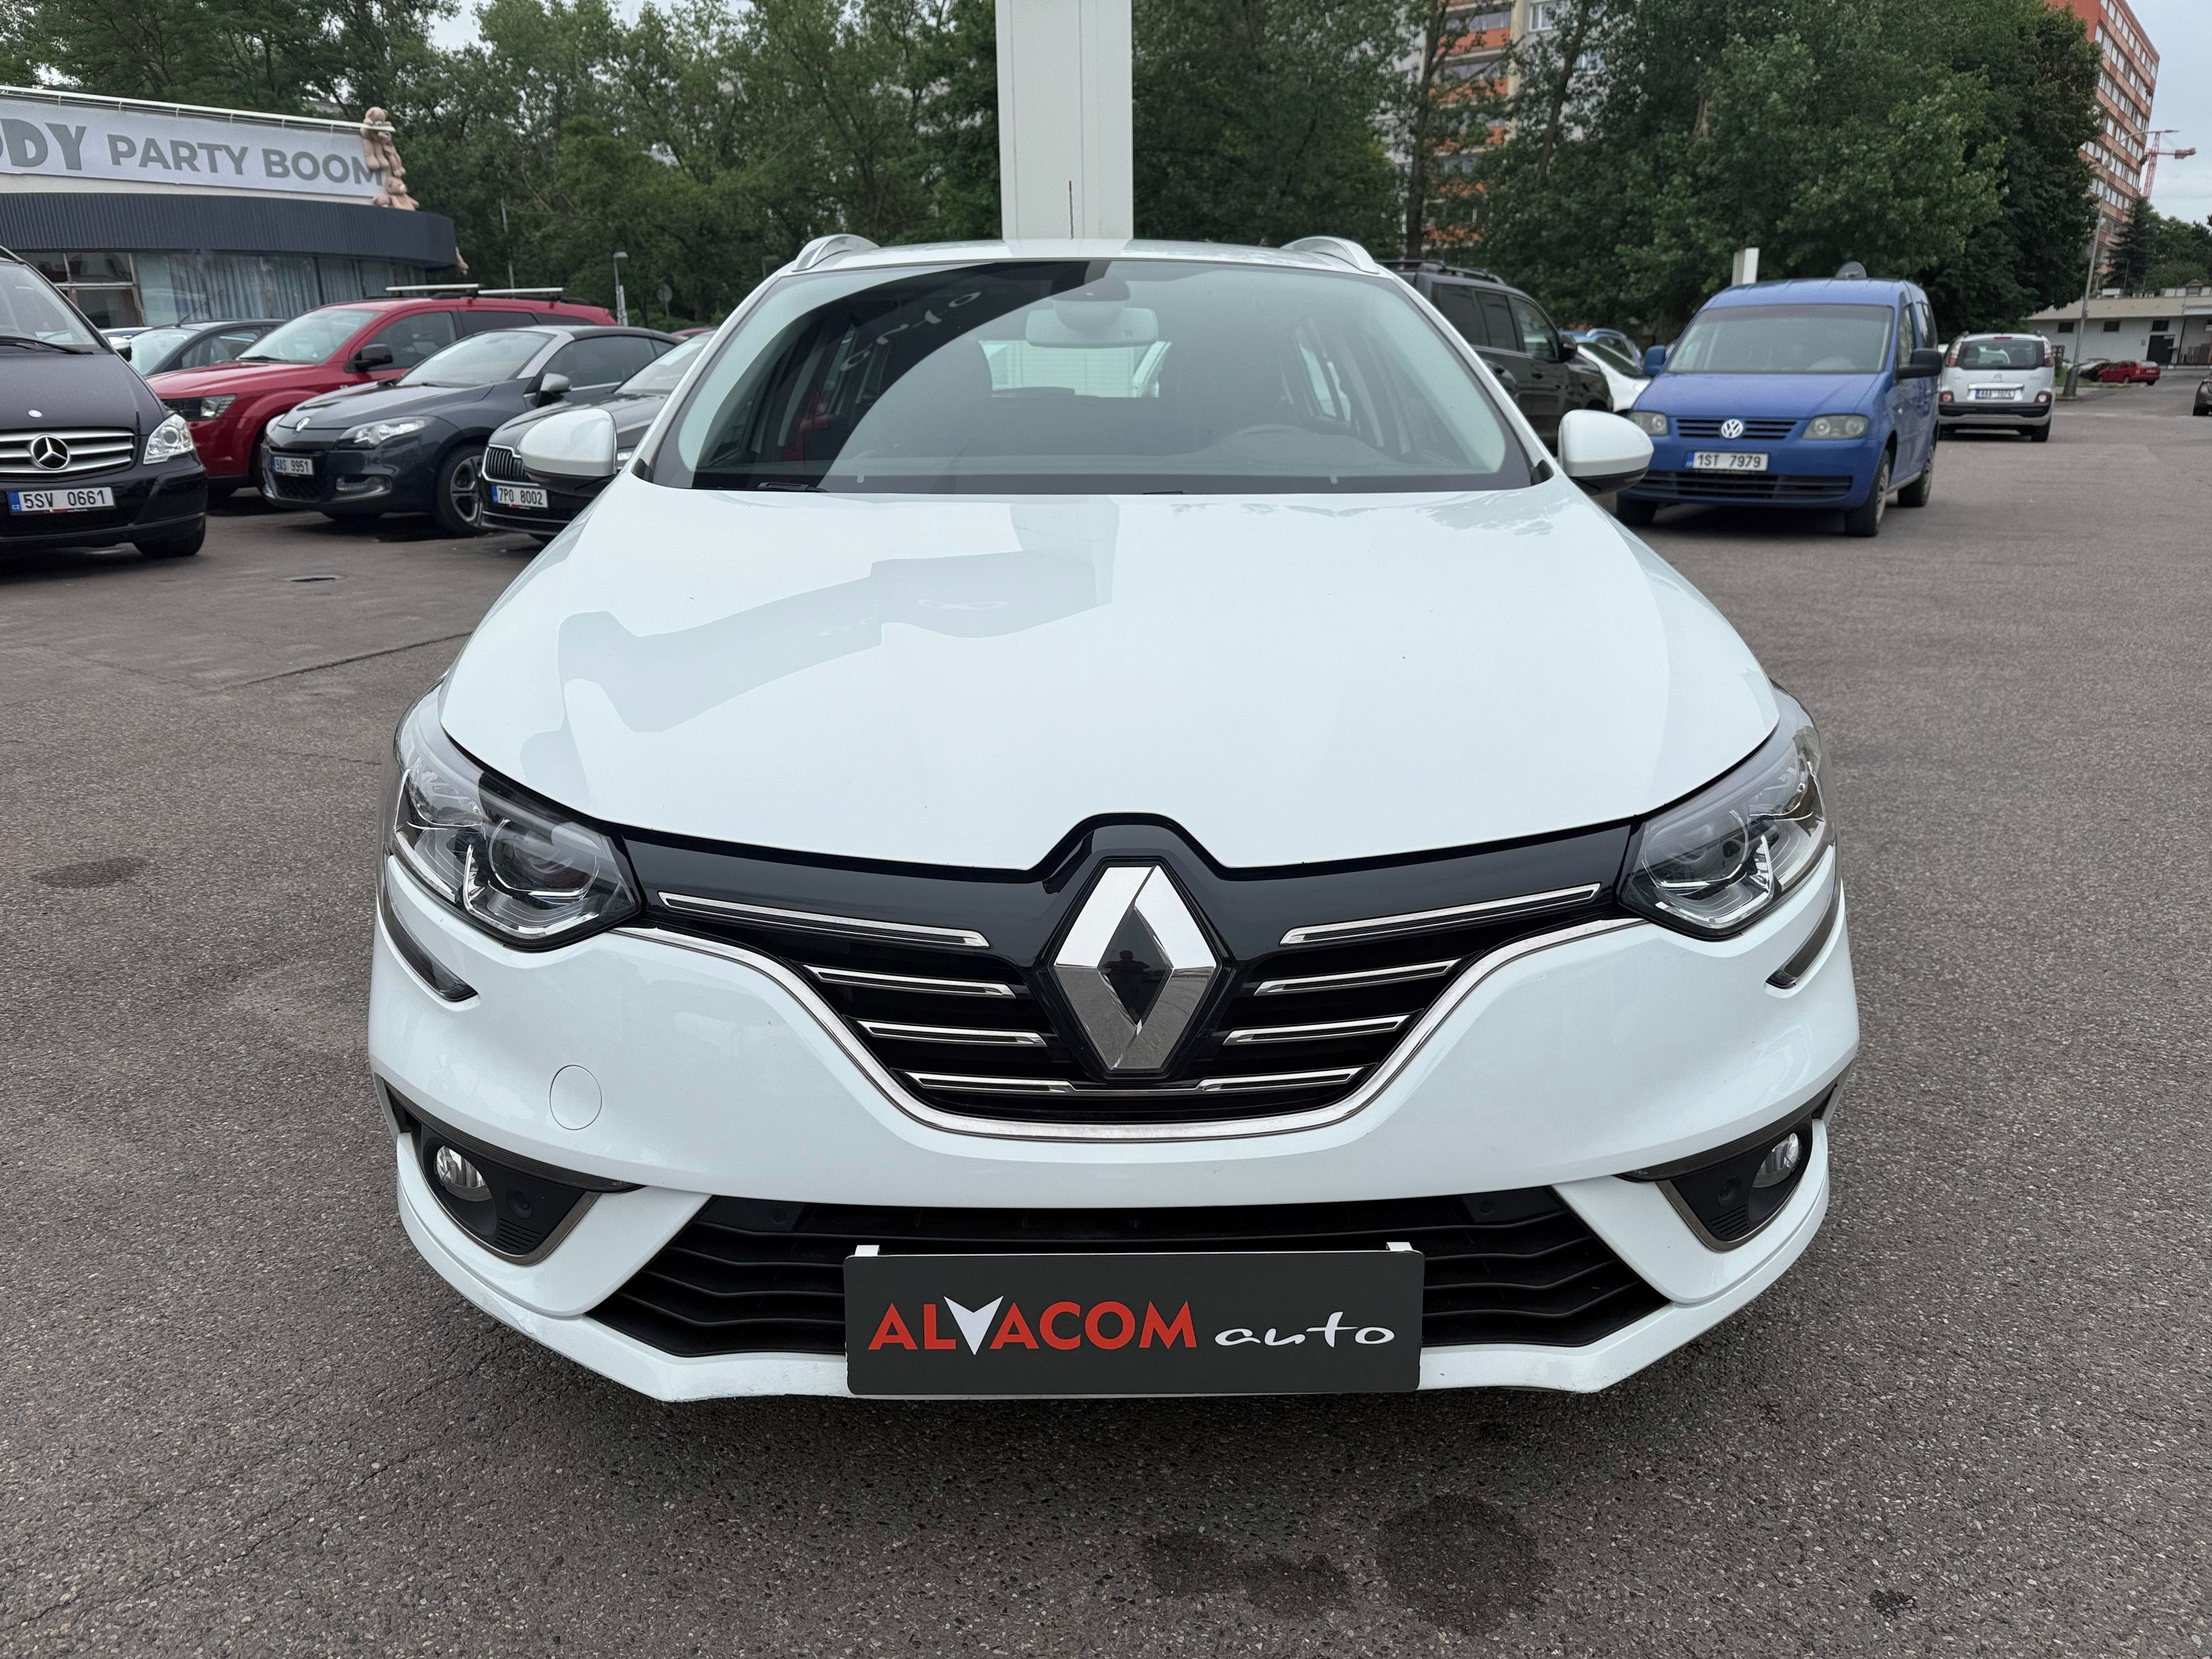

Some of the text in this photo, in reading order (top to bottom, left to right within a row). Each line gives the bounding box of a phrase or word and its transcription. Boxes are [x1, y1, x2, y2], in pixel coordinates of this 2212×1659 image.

[0, 118, 87, 171] DY
[106, 133, 249, 176] PARTY
[1697, 454, 1720, 466] 1ST
[1729, 455, 1762, 468] 7979
[22, 489, 105, 509] 5SV 0661
[498, 487, 543, 505] 7P0 8002
[867, 1295, 1396, 1356] ALVACOM auto
